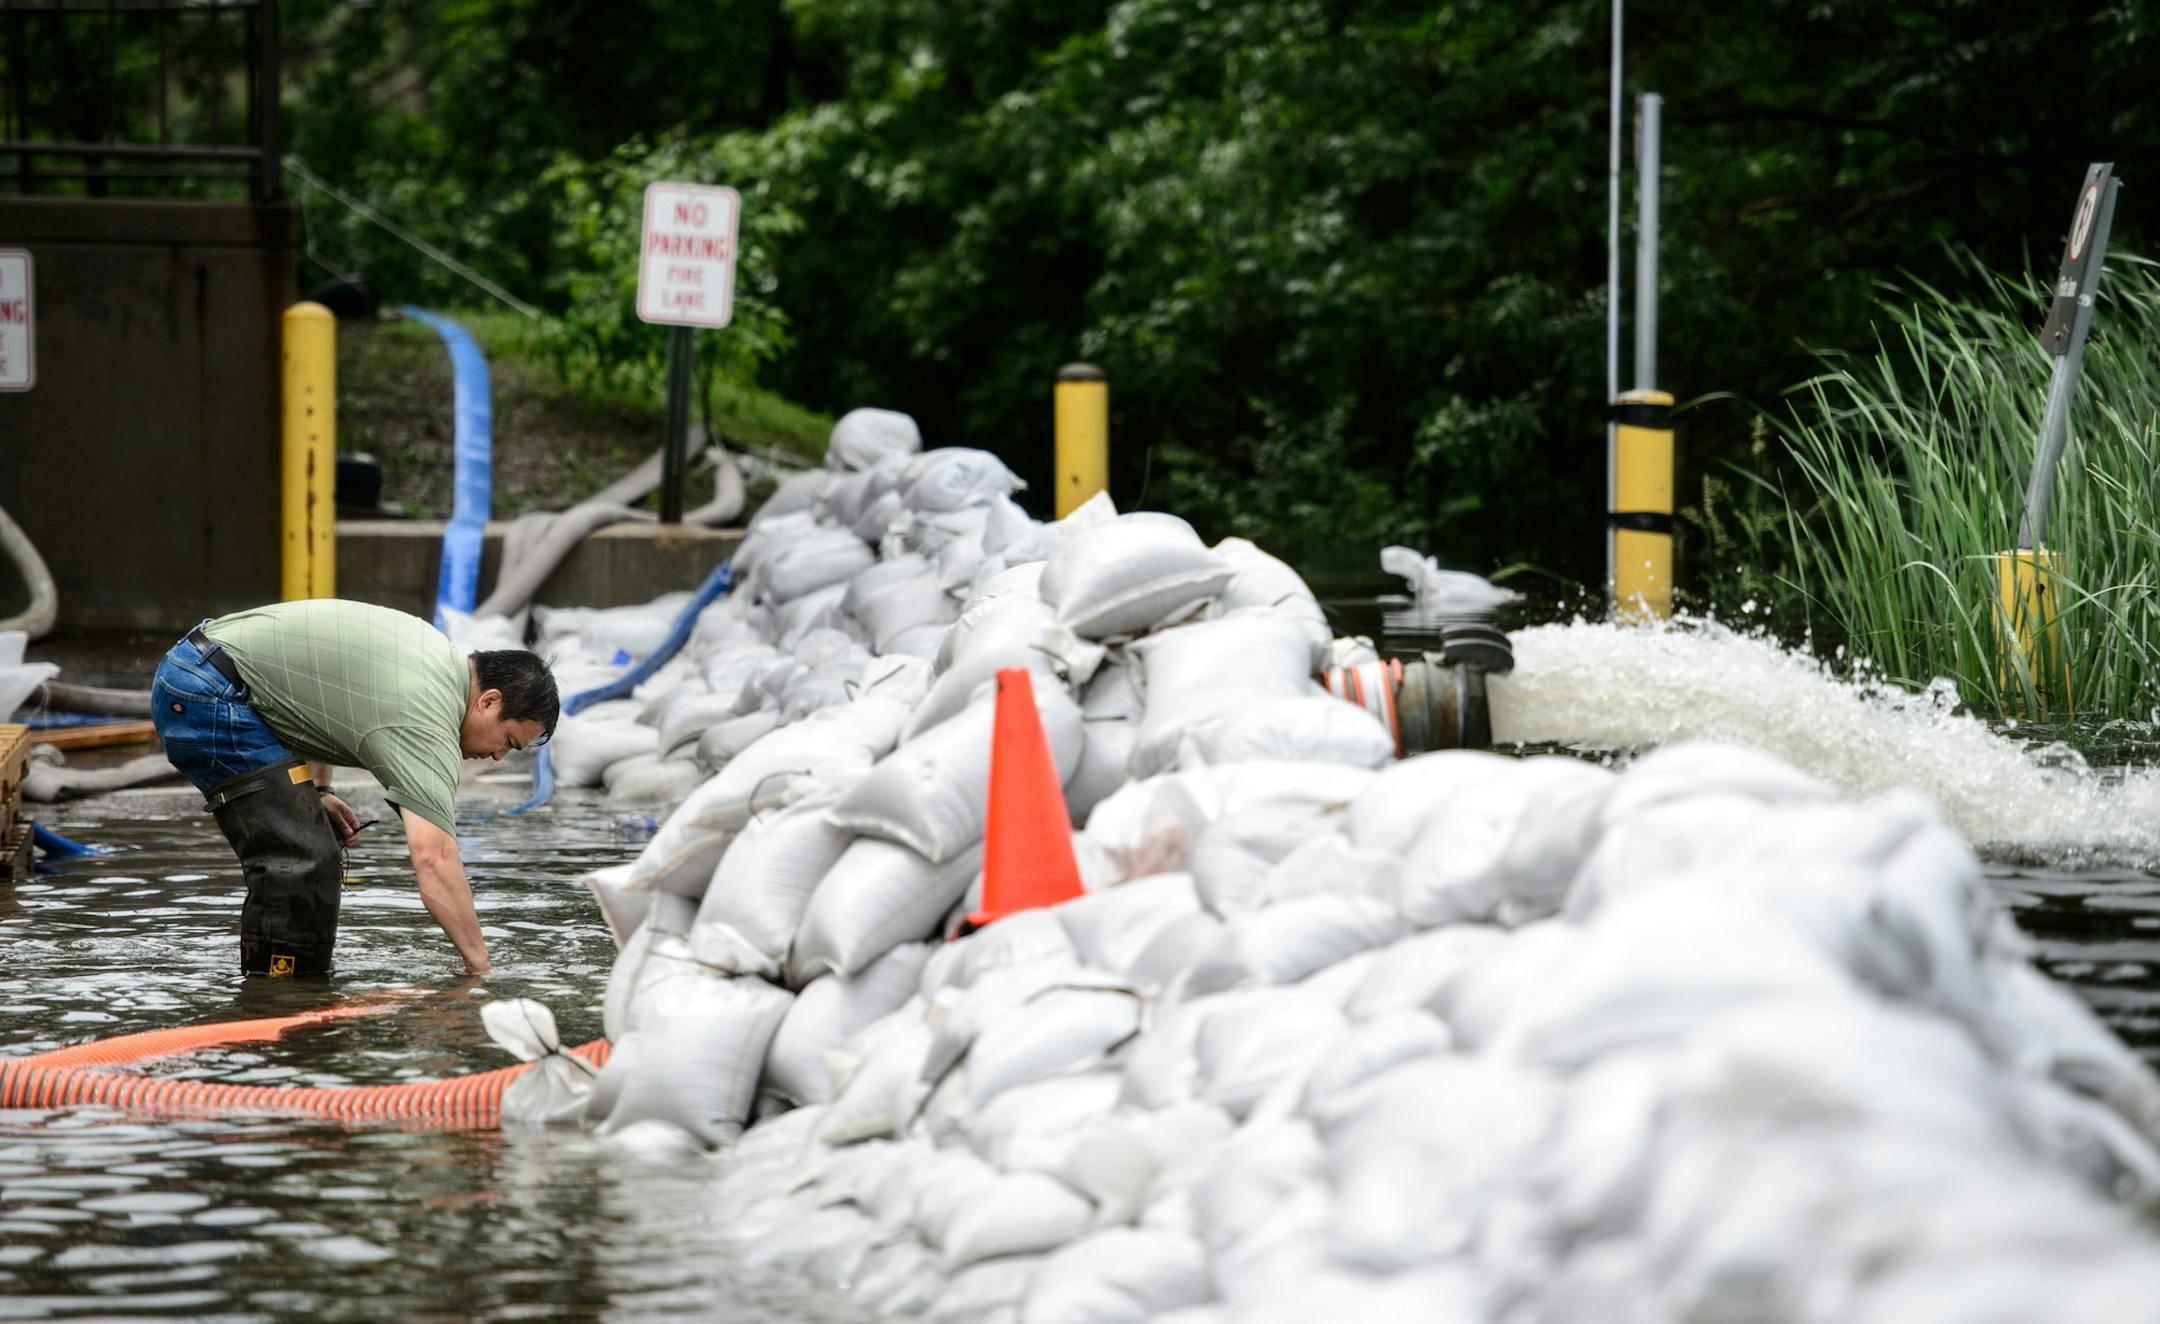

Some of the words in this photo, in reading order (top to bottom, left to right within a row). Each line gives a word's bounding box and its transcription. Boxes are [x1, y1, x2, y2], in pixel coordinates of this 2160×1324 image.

[674, 201, 709, 229] NO
[648, 231, 731, 263] PARKING
[666, 264, 704, 286] FIRE
